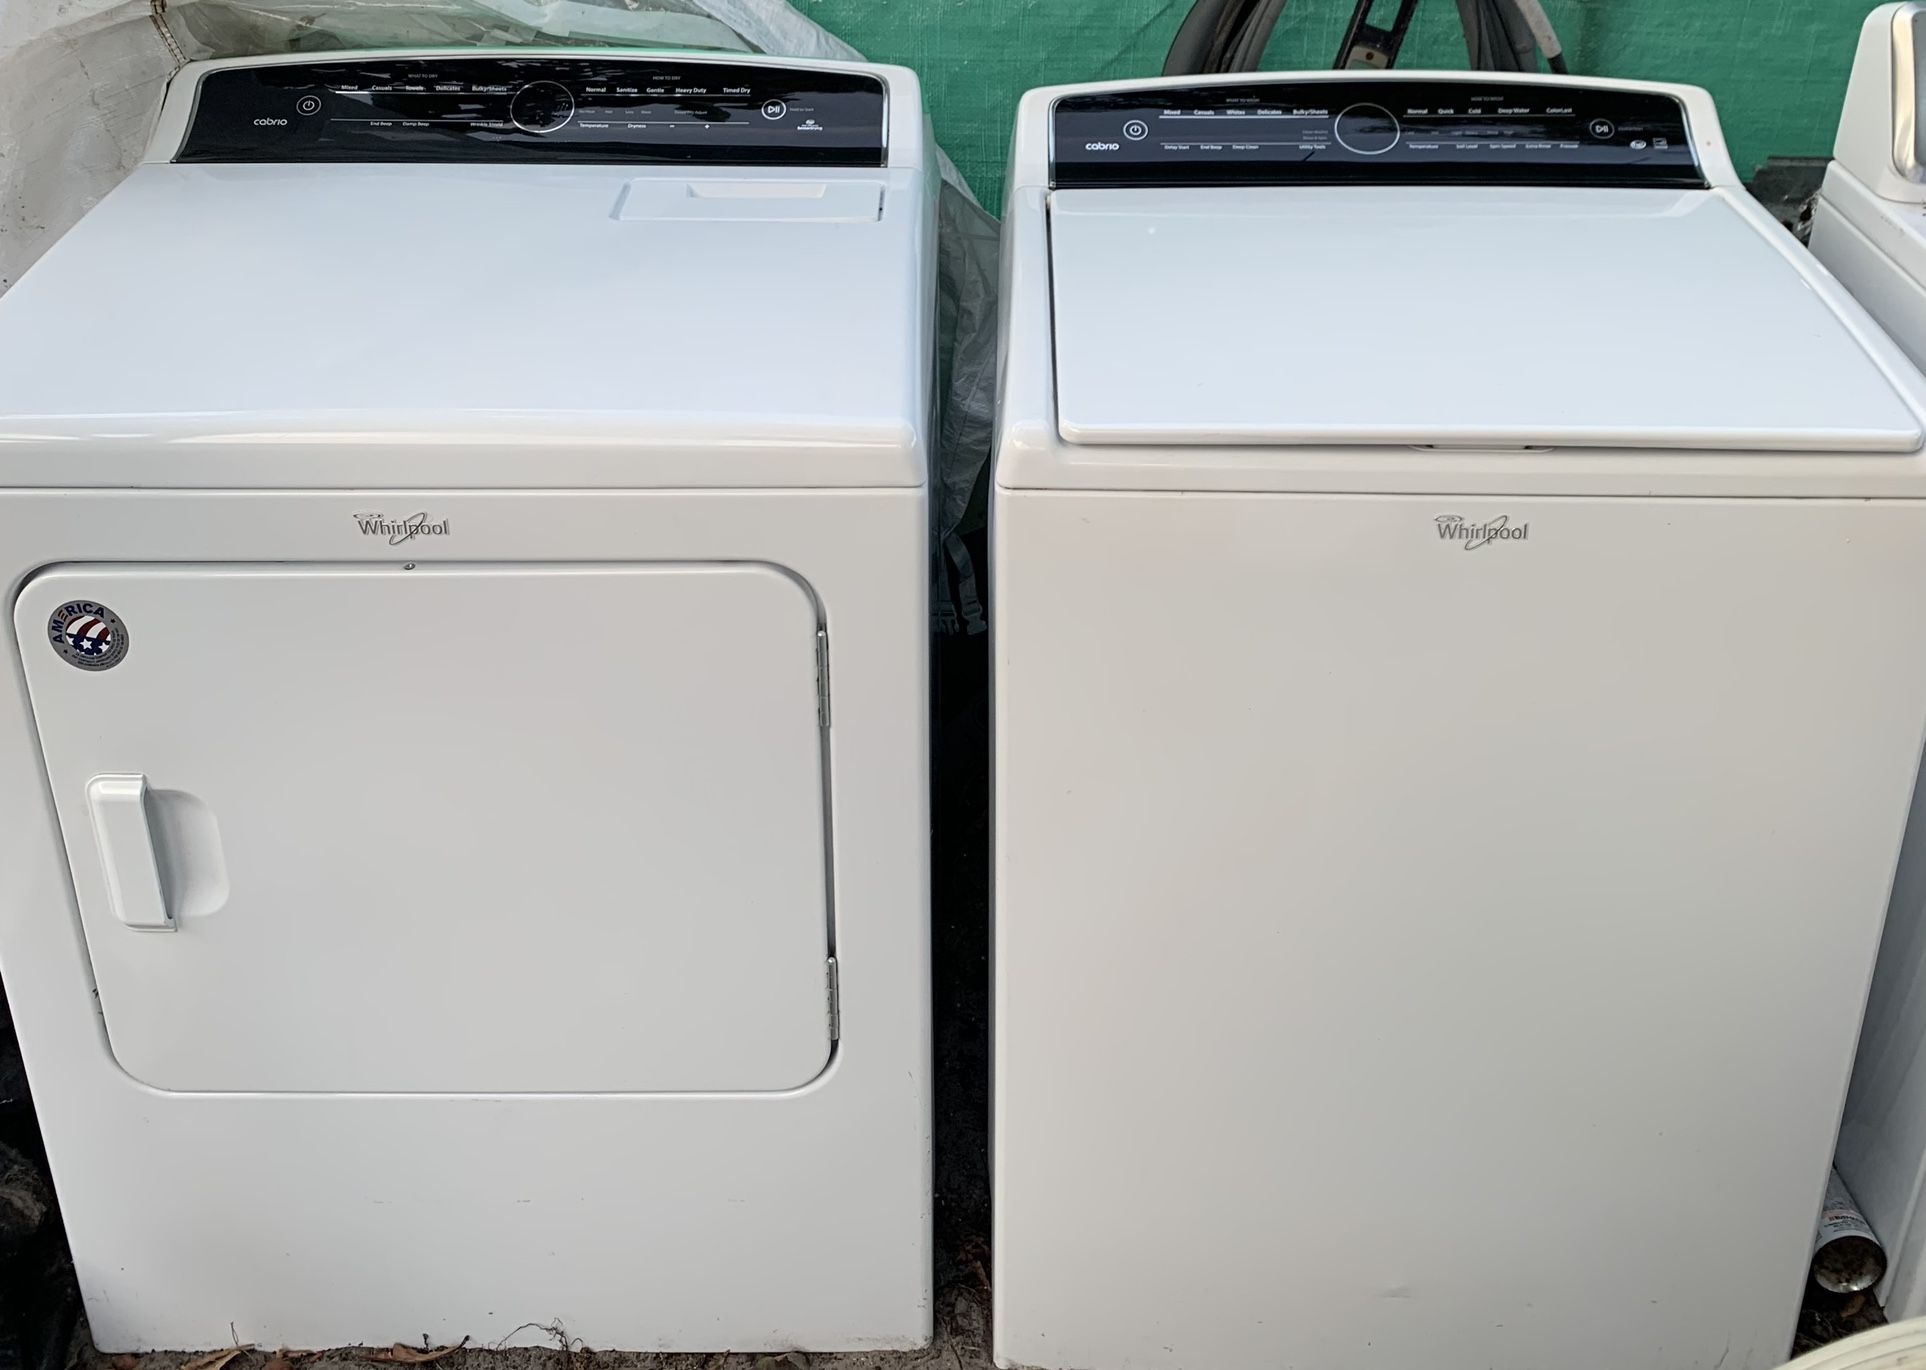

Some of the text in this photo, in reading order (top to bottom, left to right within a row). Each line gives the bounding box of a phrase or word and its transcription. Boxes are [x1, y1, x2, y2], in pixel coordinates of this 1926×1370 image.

[740, 87, 751, 95] Dry
[253, 117, 288, 126] cabrio
[1085, 142, 1120, 151] cabrio
[356, 514, 450, 543] Whirlpool
[1436, 517, 1529, 547] Whirlpool
[52, 603, 105, 644] AMERICA
